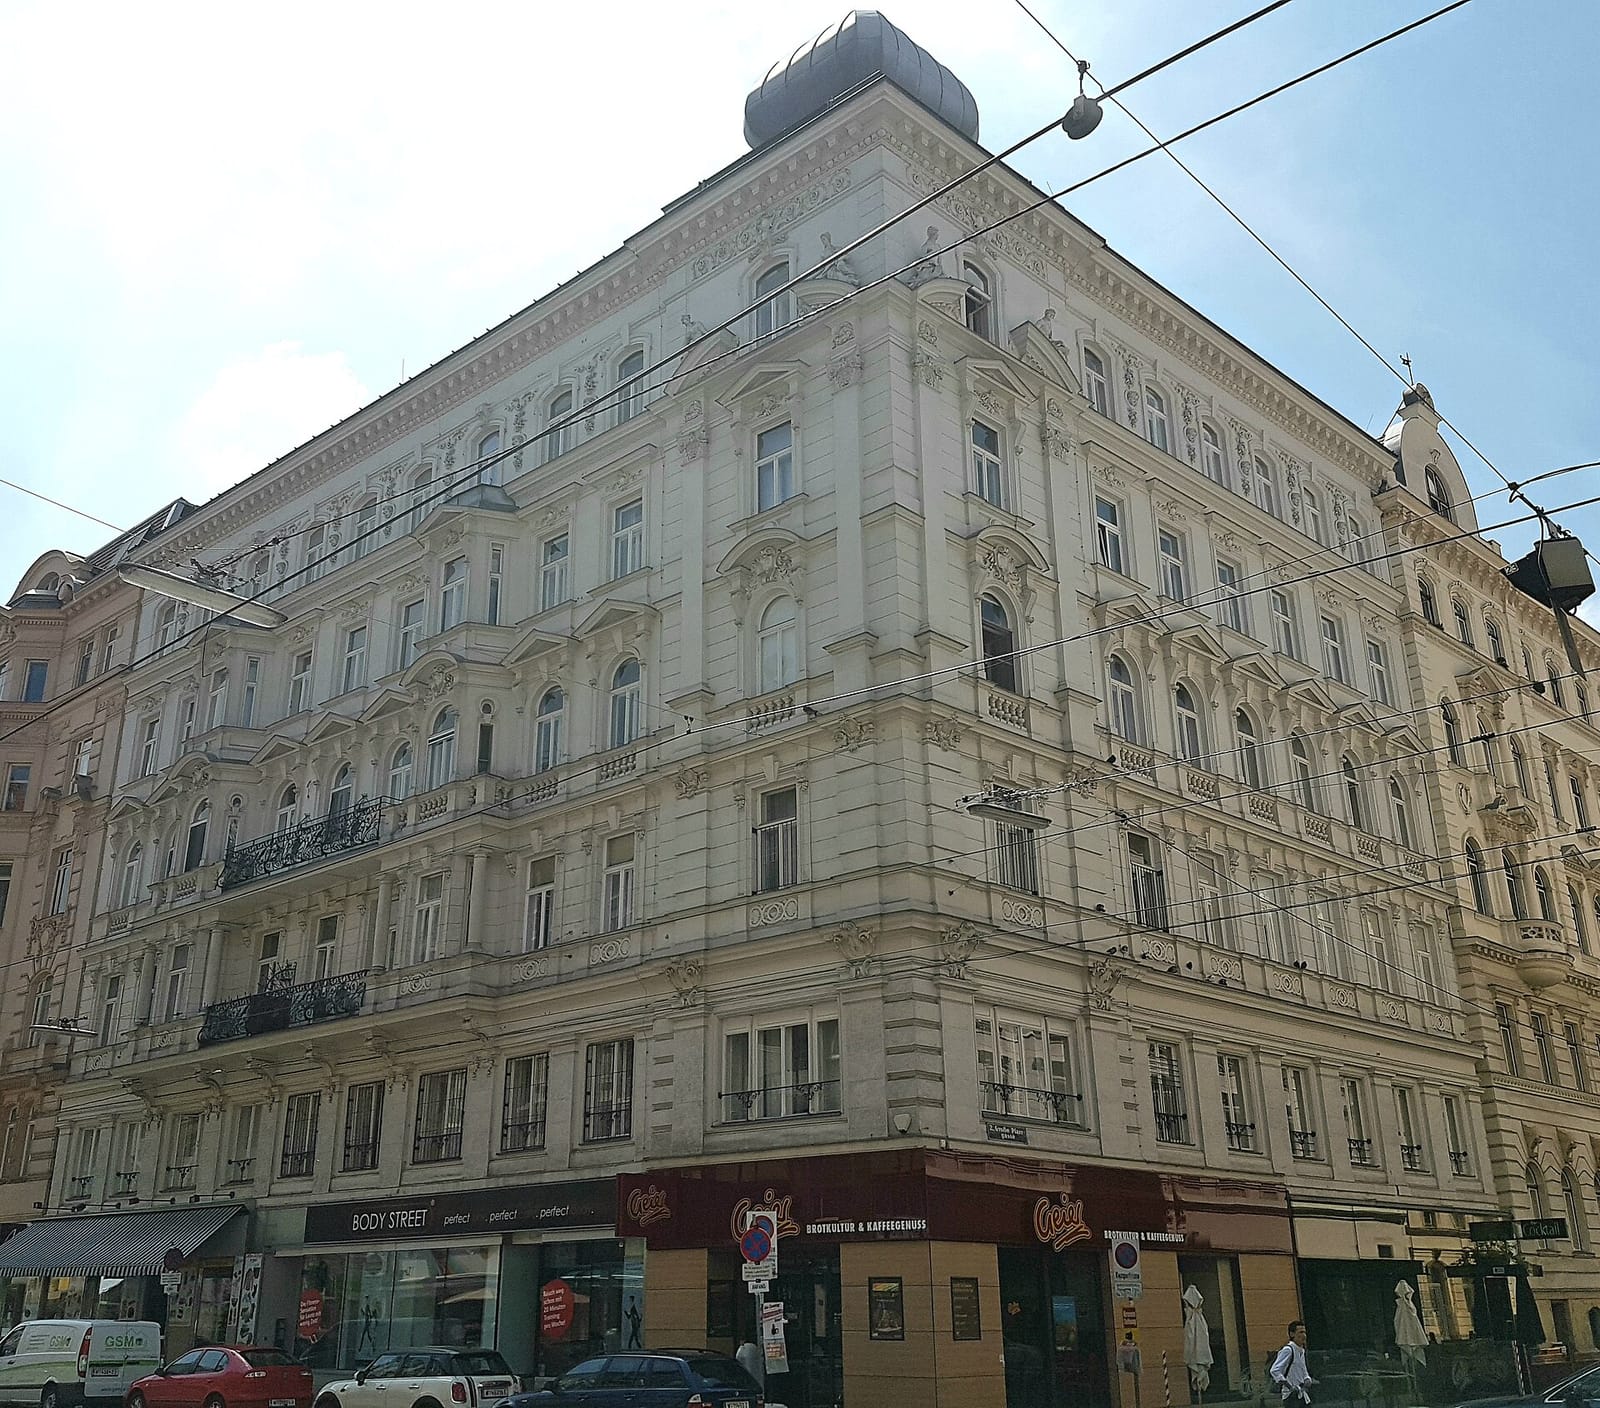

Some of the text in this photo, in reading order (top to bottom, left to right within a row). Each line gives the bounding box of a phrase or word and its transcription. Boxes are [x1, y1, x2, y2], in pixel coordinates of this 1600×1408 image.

[352, 1209, 428, 1231] BODY STREET
[443, 1205, 570, 1227] perfect perfect perfect
[806, 1219, 927, 1234] BROTKULTUR & KAFFEEGENUSS
[1522, 1221, 1561, 1237] Cocktail
[1141, 1232, 1146, 1241] &
[104, 1335, 135, 1348] GSM
